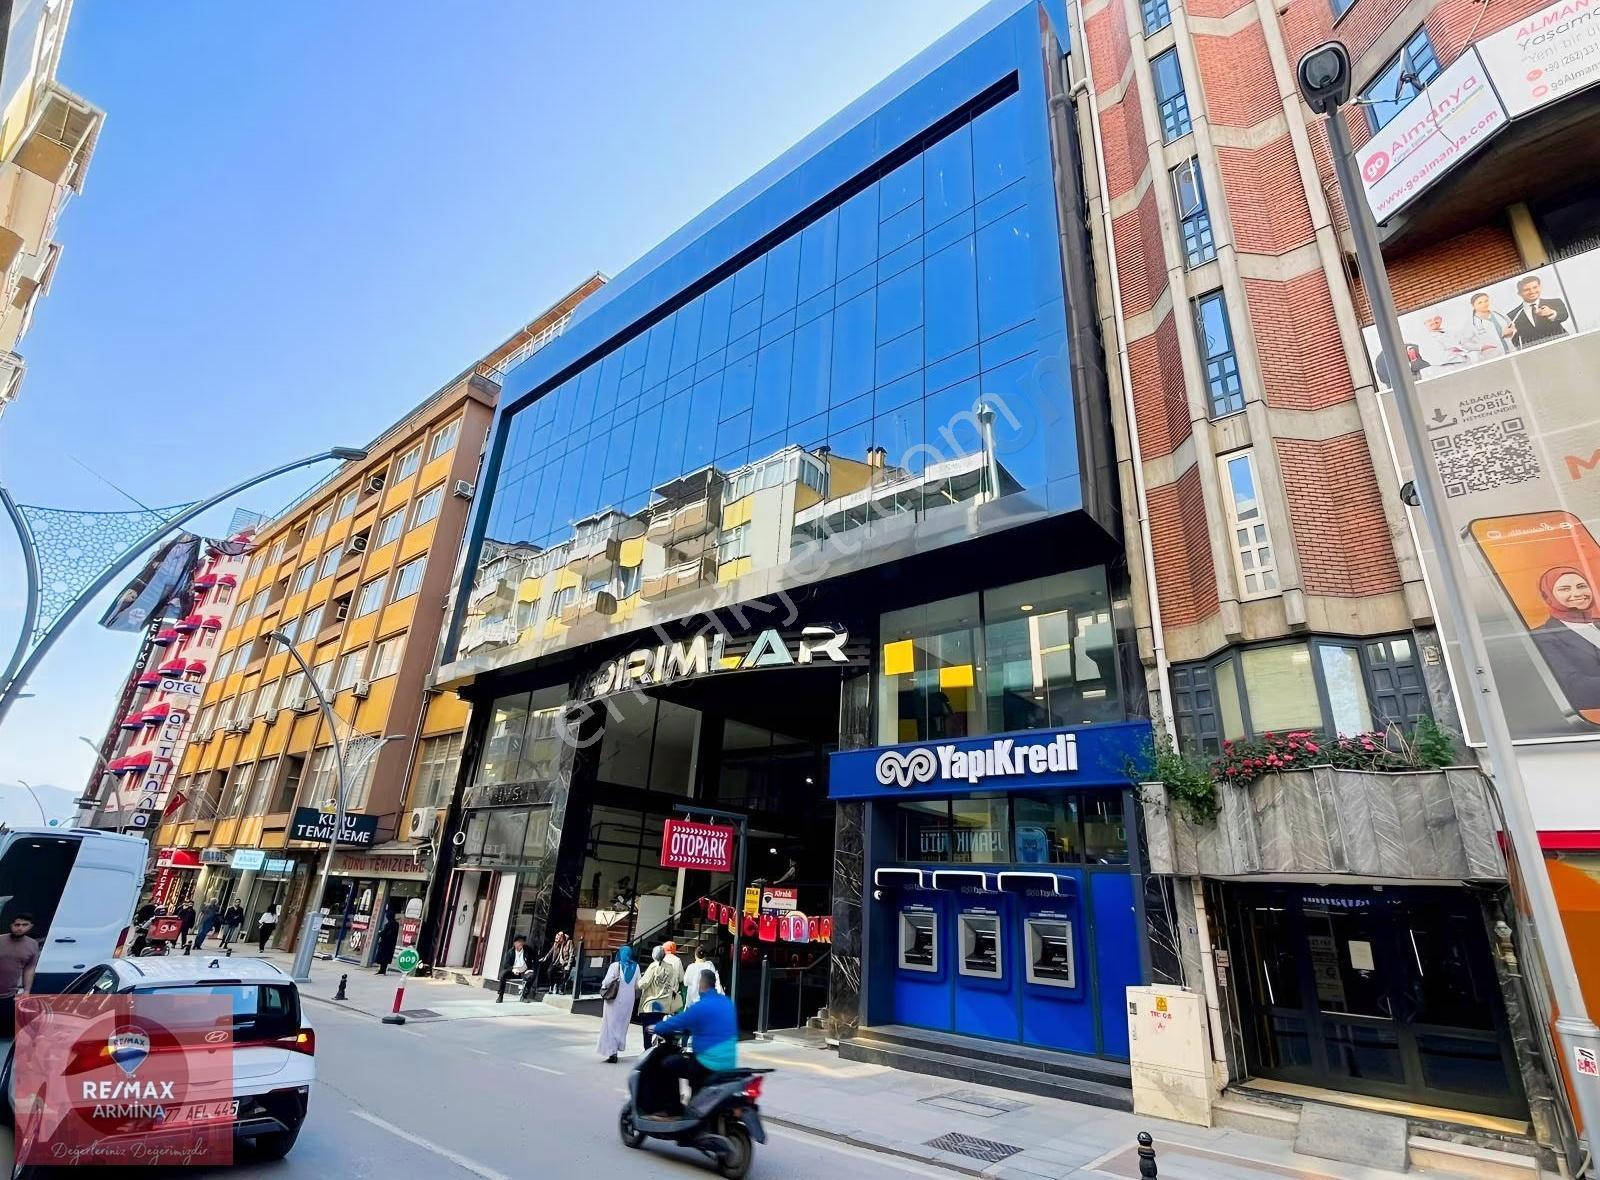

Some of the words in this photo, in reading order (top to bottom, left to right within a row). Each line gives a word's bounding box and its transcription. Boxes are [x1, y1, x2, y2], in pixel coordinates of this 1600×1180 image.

[1551, 62, 1600, 91] goAlman
[1392, 76, 1477, 156] Almanya
[1366, 157, 1384, 178] go
[1376, 109, 1498, 212] www.goalmanya.com
[163, 679, 201, 695] OTEL
[937, 733, 1079, 783] YapıKredi
[319, 813, 357, 828] KUU
[671, 833, 727, 859] OTOPARK
[186, 1104, 208, 1120] AEL
[214, 1101, 237, 1116] 445
